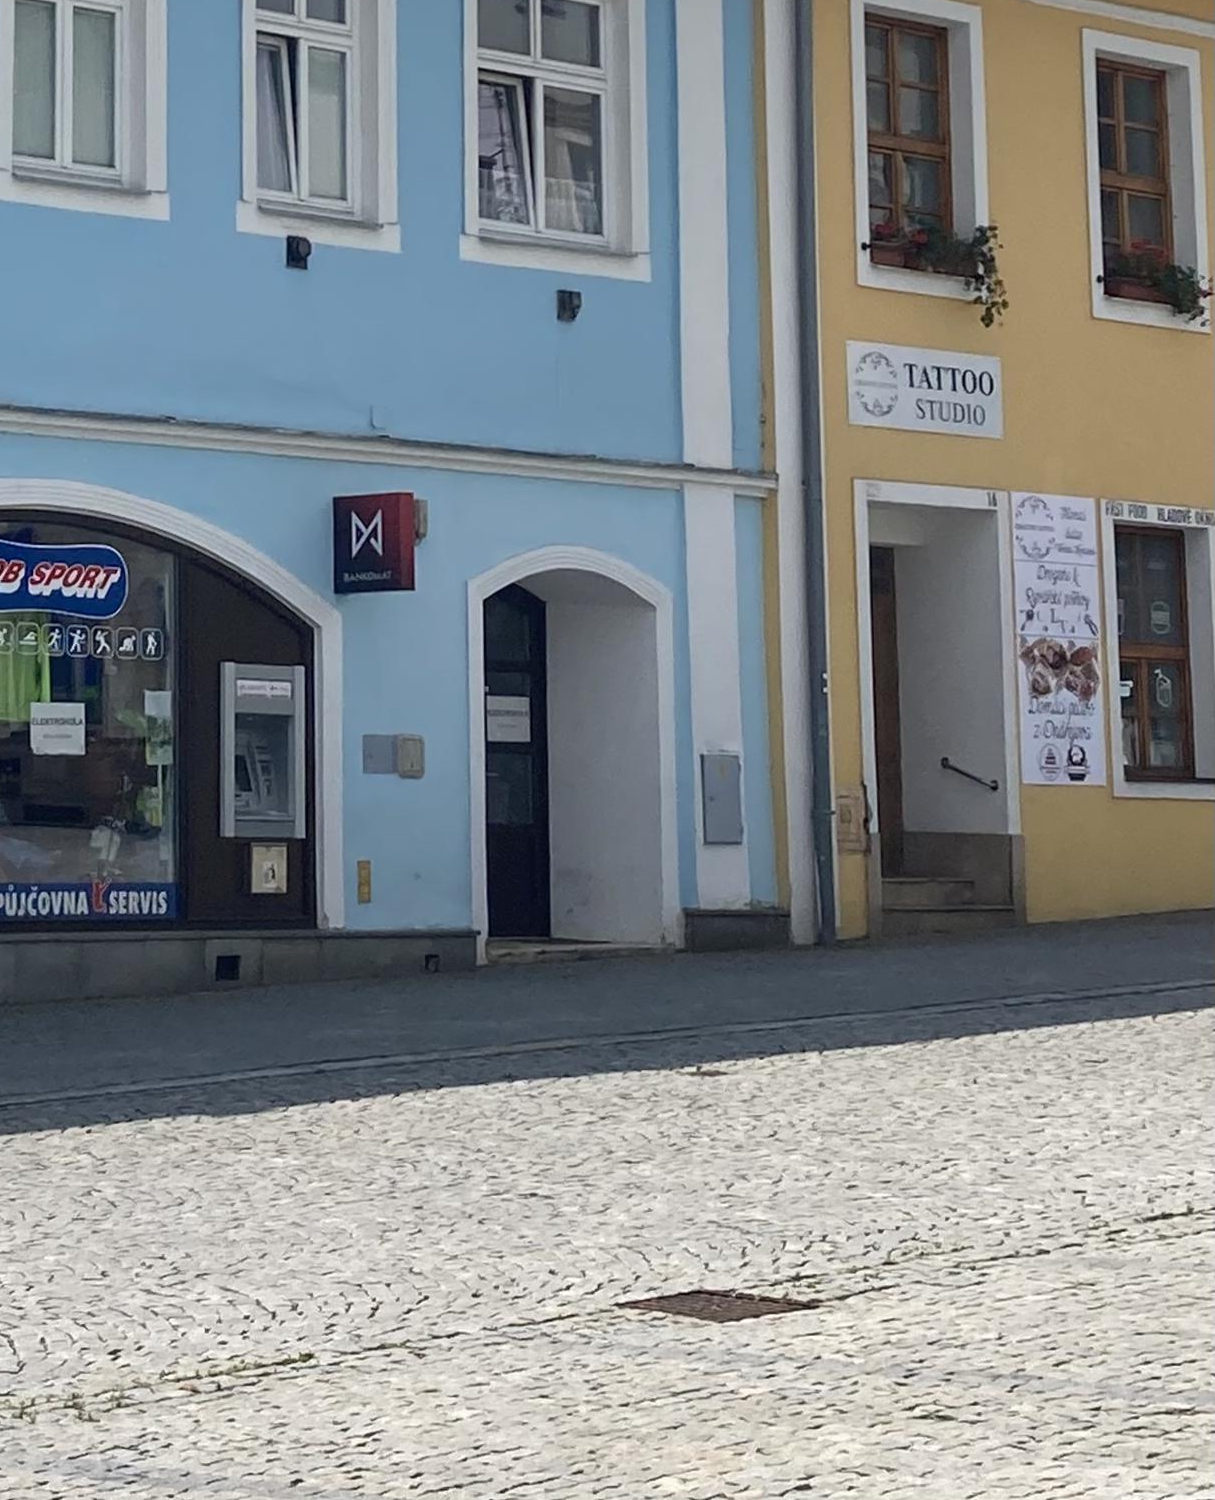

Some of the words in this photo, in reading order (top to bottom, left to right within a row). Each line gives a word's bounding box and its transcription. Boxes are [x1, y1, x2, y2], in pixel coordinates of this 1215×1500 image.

[903, 363, 994, 396] TATTOO
[915, 398, 986, 426] STUDIO
[28, 561, 122, 599] SPORT
[108, 891, 167, 915] SERVIS
